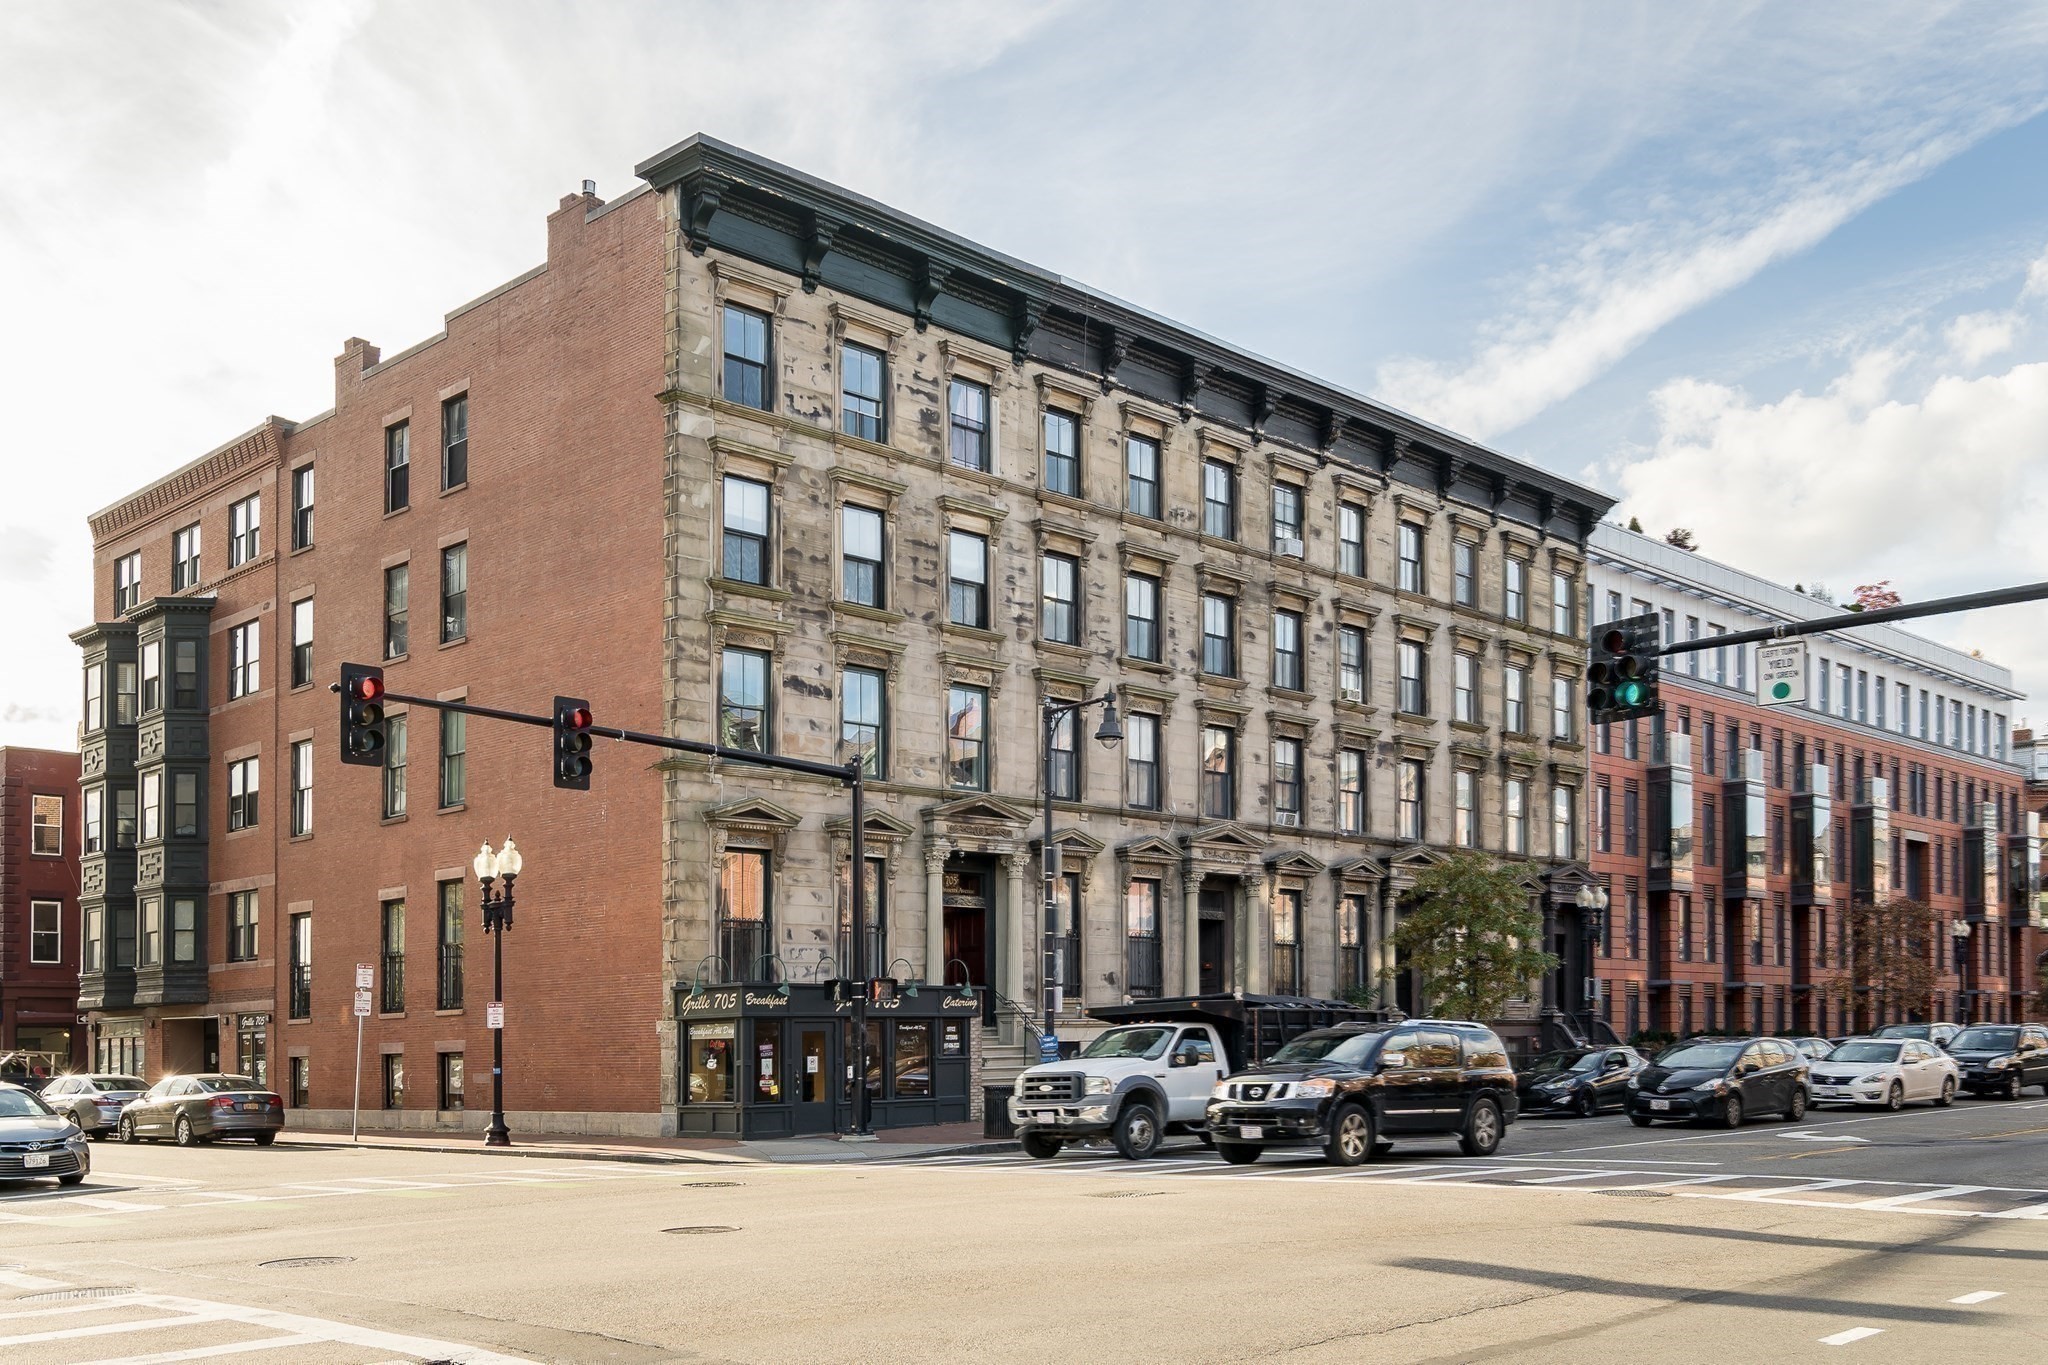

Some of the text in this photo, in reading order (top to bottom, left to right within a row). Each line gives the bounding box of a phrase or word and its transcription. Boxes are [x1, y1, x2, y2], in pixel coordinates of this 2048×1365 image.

[1762, 647, 1799, 658] LEFT TURN
[1768, 658, 1793, 669] YIELD
[1776, 670, 1799, 679] GREEN
[945, 876, 958, 885] 705
[682, 993, 737, 1016] Grille 705
[745, 992, 788, 1008] Breakfast
[943, 995, 977, 1009] Catering
[242, 1016, 265, 1028] Grille 705
[690, 1027, 713, 1036] Breakfast
[723, 1026, 734, 1035] Day
